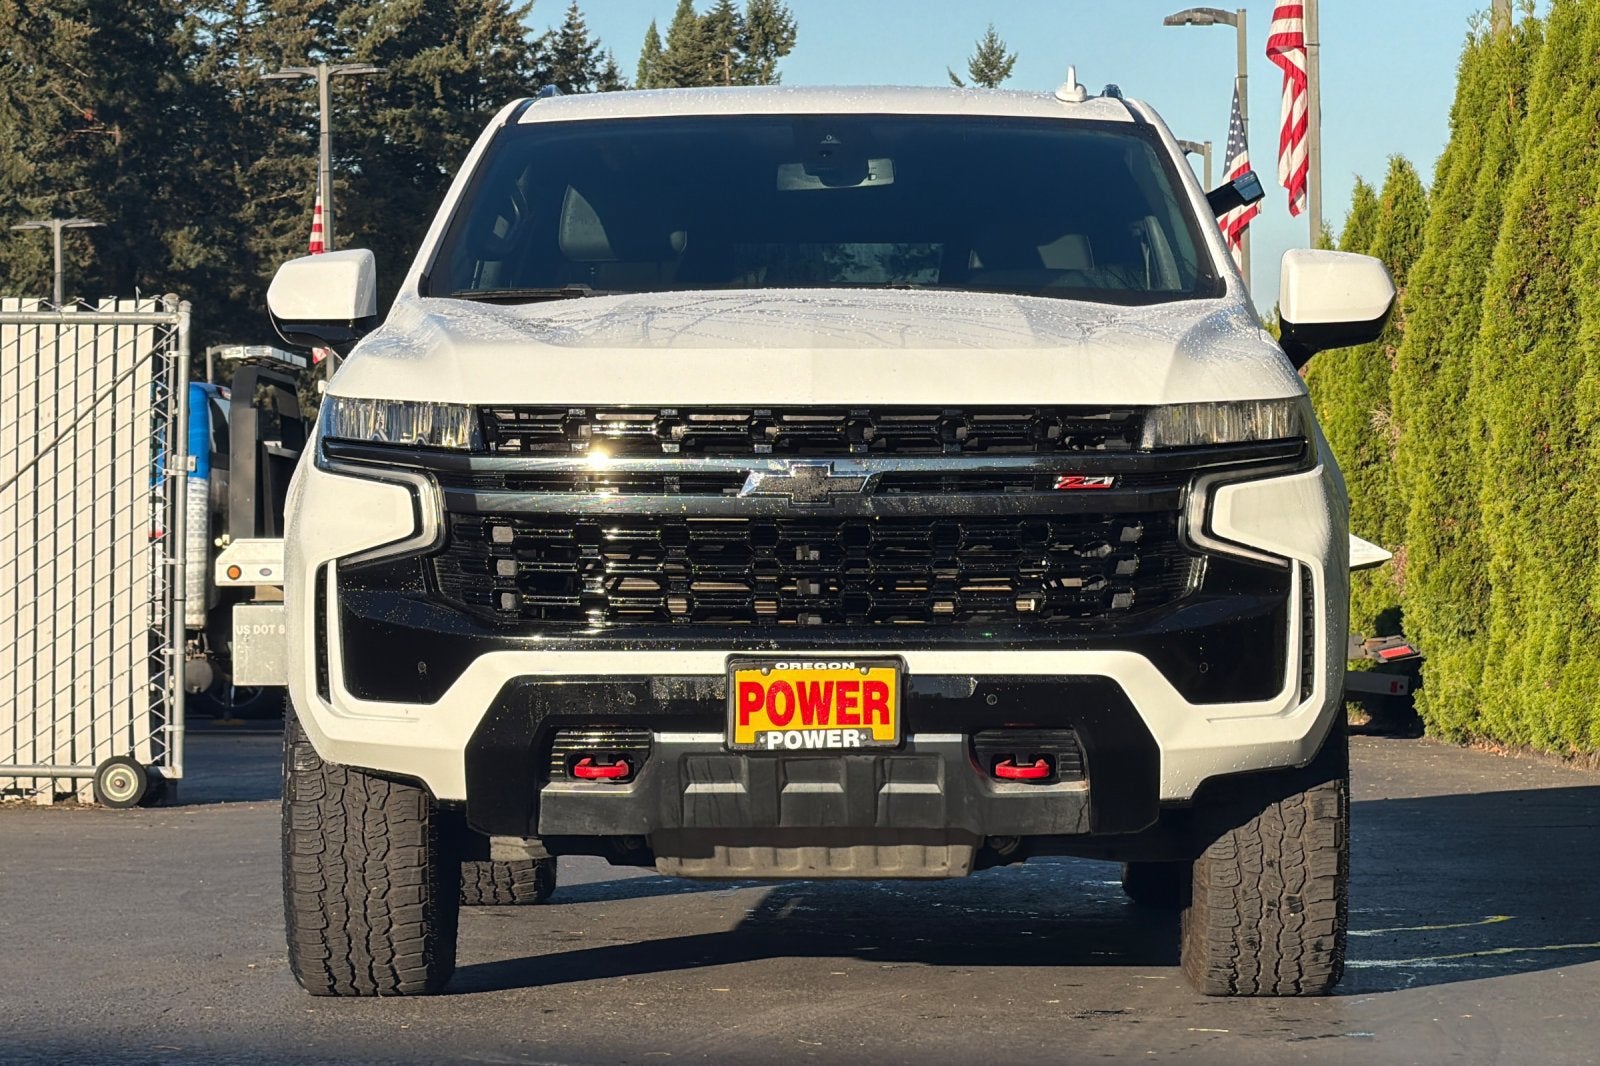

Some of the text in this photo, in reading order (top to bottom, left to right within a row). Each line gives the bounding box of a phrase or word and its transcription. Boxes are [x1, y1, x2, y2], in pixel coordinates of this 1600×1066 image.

[236, 625, 250, 635] US
[253, 625, 276, 635] DOT
[775, 662, 855, 670] OREGON
[739, 680, 890, 727] POWER
[767, 729, 860, 750] POWER
